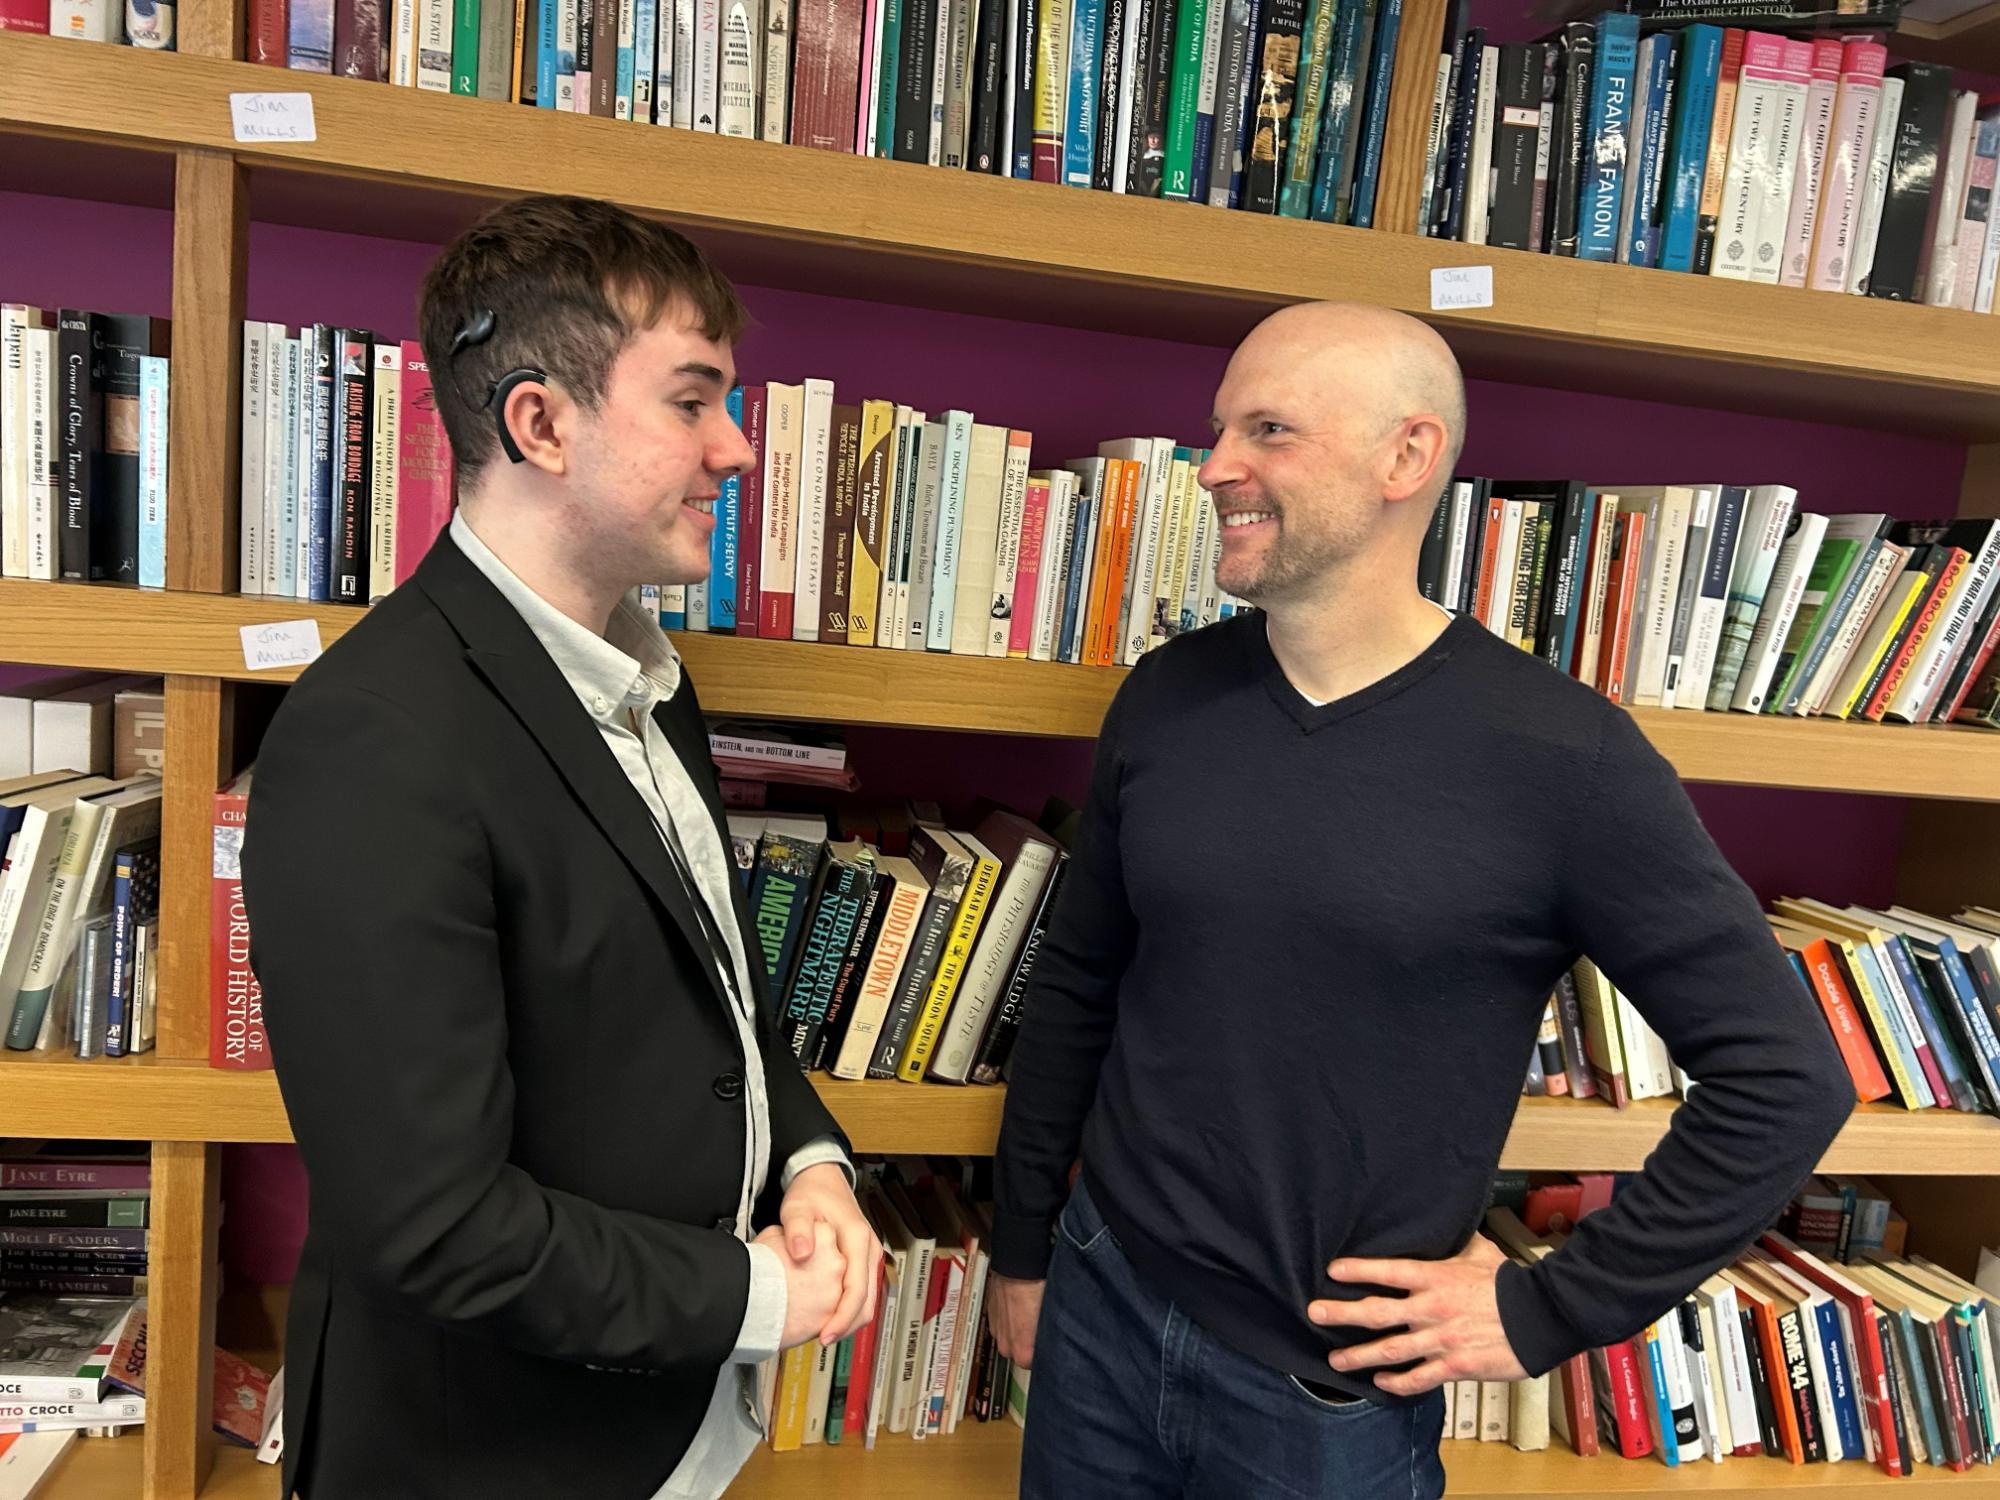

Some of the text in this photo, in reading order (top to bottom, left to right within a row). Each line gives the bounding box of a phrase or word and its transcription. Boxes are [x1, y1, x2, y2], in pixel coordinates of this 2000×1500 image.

[430, 13, 439, 45] STATE
[565, 12, 574, 43] Ocean
[1108, 0, 1121, 64] CONFRONTING
[1189, 12, 1203, 62] OF INDIA
[1652, 5, 1795, 19] GLOBAL DRUG HISTORY
[767, 45, 778, 104] NORWICH
[1078, 9, 1097, 135] VICTORIANS AND SPORT
[1109, 66, 1118, 82] THE
[1154, 12, 1172, 121] Modern England Withington
[1107, 84, 1116, 108] BODY
[1570, 63, 1587, 166] Colonizing the Body
[1753, 95, 1764, 117] THE
[243, 125, 297, 138] MILLS
[1593, 76, 1626, 238] FRANTZ FANON
[1772, 98, 1795, 199] HISTORIOGRAPHY
[1800, 96, 1831, 243] THE ORIGINS OF EMPIRE
[1837, 101, 1869, 249] THE EIGHTEENTH CENTURY
[1734, 186, 1750, 235] CENTURY
[1439, 293, 1483, 306] MILLS
[4, 318, 26, 368] Japan
[65, 354, 82, 528] Crowns of Glory, Tears of Blood
[1008, 458, 1027, 466] IYER
[345, 382, 363, 558] ARISING FROM BONDAGE RON RAMDIN
[783, 466, 791, 518] Anglo-Maratha
[813, 451, 825, 518] ECONOMICS
[868, 450, 883, 545] Arrested Development
[942, 423, 963, 578] SEN DISCIPLINING PUNISHMENT
[998, 468, 1015, 567] OF MAHATMA GANDHI
[1005, 471, 1025, 583] THE ESSENTIAL WRITINGS
[1168, 495, 1181, 544] SUBALTERN
[1719, 503, 1734, 544] RICHARD
[724, 489, 736, 579] RAJPUT & SEPOY
[780, 520, 789, 561] Campaigns
[812, 526, 819, 535] of
[1020, 504, 1034, 558] CHILDREN
[1030, 506, 1045, 558] MIDNIGHT'S
[1142, 494, 1163, 595] SUBALTERN STUDIES VIII
[1189, 500, 1209, 592] SUBALTERN STUDIES VI
[1866, 549, 1877, 562] The
[808, 544, 818, 598] ECSTASY
[1163, 545, 1174, 579] STUDIES
[1511, 516, 1537, 629] WORKING FOR FORD
[1560, 535, 1577, 616] MAGDALEN LAUNDRIES
[1855, 562, 1871, 584] Winter
[1966, 577, 1985, 597] WAR
[1978, 565, 1992, 579] OF
[1830, 593, 1856, 629] Discontent
[1943, 617, 1964, 645] TRADE
[1957, 596, 1972, 617] AND
[257, 650, 310, 664] MILLS
[30, 878, 65, 974] ON THE EDGE OF DEMOCRACY
[112, 905, 125, 998] POINT OF ORDER!
[806, 869, 860, 1025] THE THERAPEUTIC
[865, 888, 920, 998] MIDDLETOWN
[225, 885, 250, 1063] WORLD HISTORY
[787, 890, 841, 1021] NIGHTMARE
[827, 890, 879, 1024] UPTON SINCLAIR The Cup of Fury
[916, 863, 993, 1055] DEBORAH BLUM THE POISON SQUAD
[1000, 928, 1047, 1025] KNOWLEDGE
[1818, 962, 1853, 1034] Double Lives
[248, 1030, 263, 1052] OF
[8, 1169, 96, 1184] JANE EYRE
[1, 1232, 119, 1245] MOLL FLANDERS
[10, 1208, 68, 1218] JANE EYRE
[915, 1249, 930, 1300] Giovanni Contini
[902, 1320, 920, 1382] LA MEMORIA DIVISA
[1780, 1312, 1809, 1390] ROME '44
[1829, 1341, 1845, 1398] Un'altra storia
[29, 1405, 74, 1415] CROCE
[1622, 1356, 1638, 1420] La Grande Bugia
